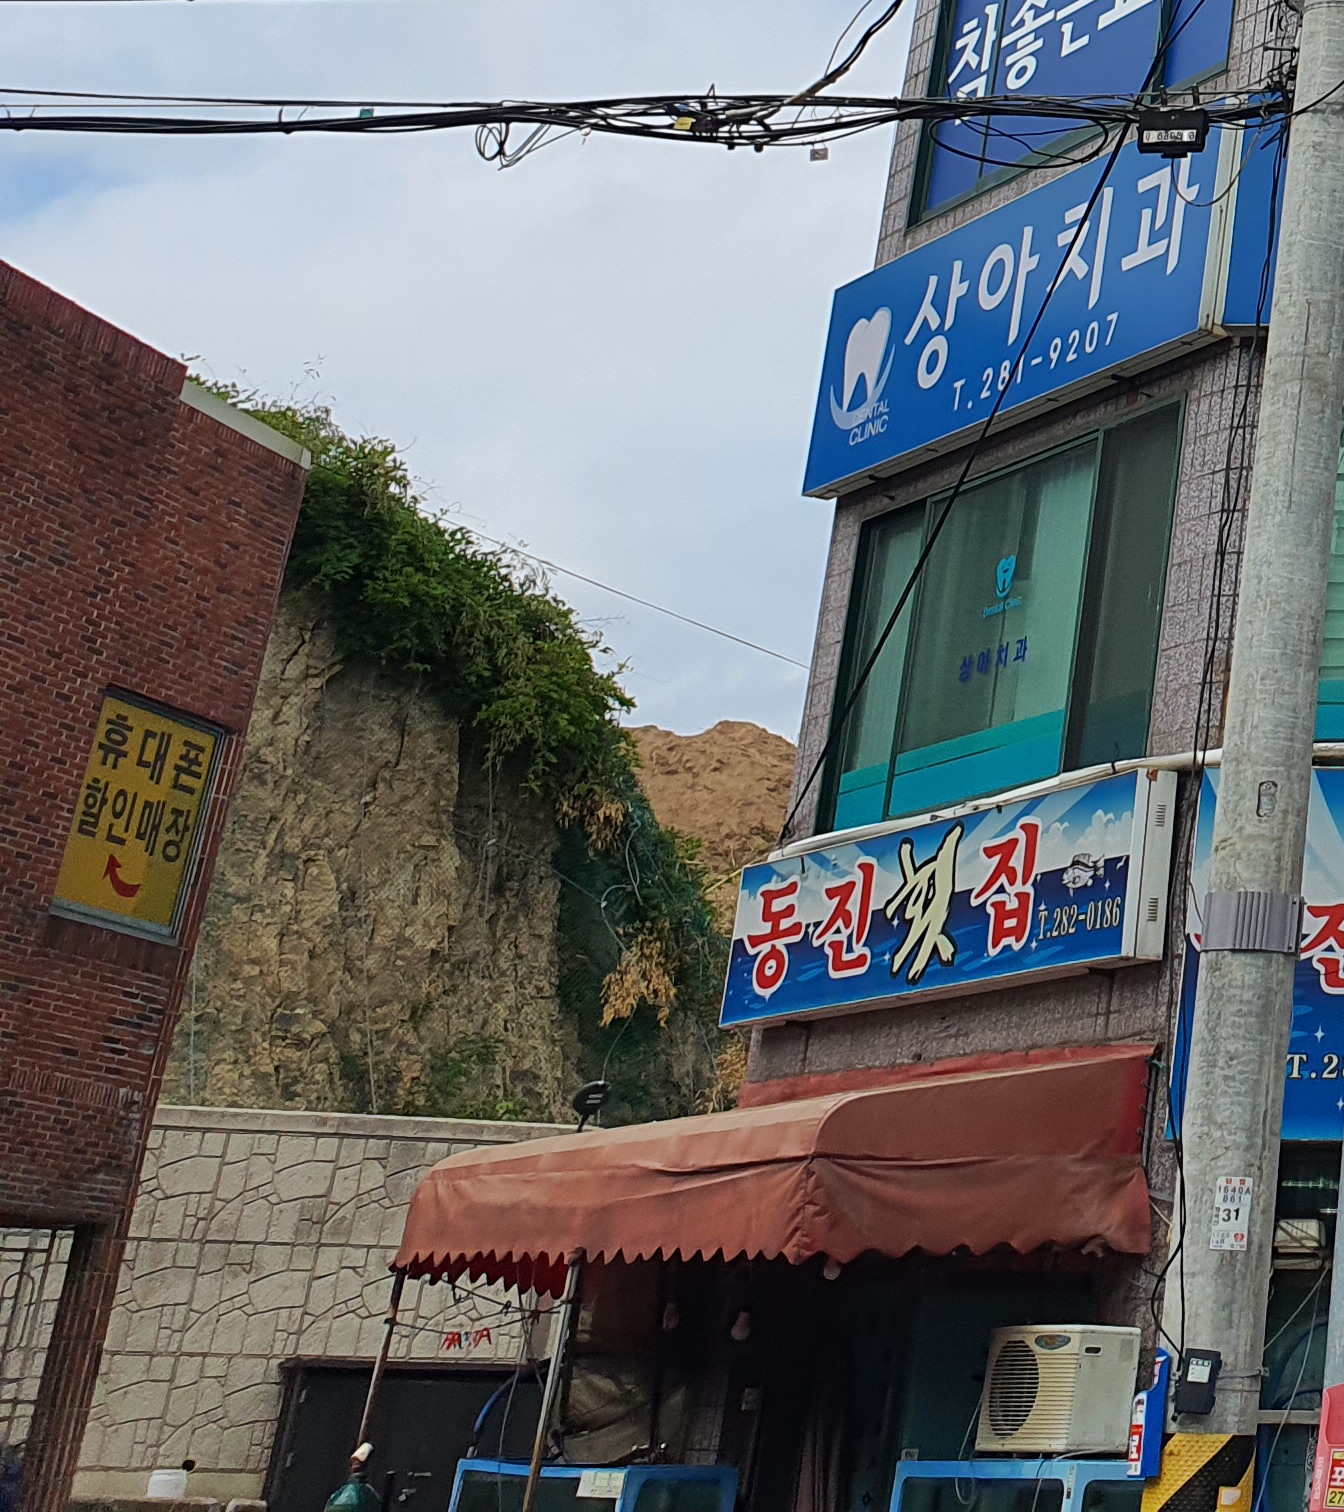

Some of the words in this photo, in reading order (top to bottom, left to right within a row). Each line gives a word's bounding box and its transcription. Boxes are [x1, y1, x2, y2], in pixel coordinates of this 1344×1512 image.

[904, 152, 1200, 390] 상아치과
[953, 311, 1119, 412] T.281-9207
[849, 414, 889, 446] CLINIC
[98, 713, 205, 796] 휴대폰
[77, 776, 191, 863] 할인매장
[1037, 896, 1122, 942] T.282-0186
[1221, 1207, 1240, 1223] 31
